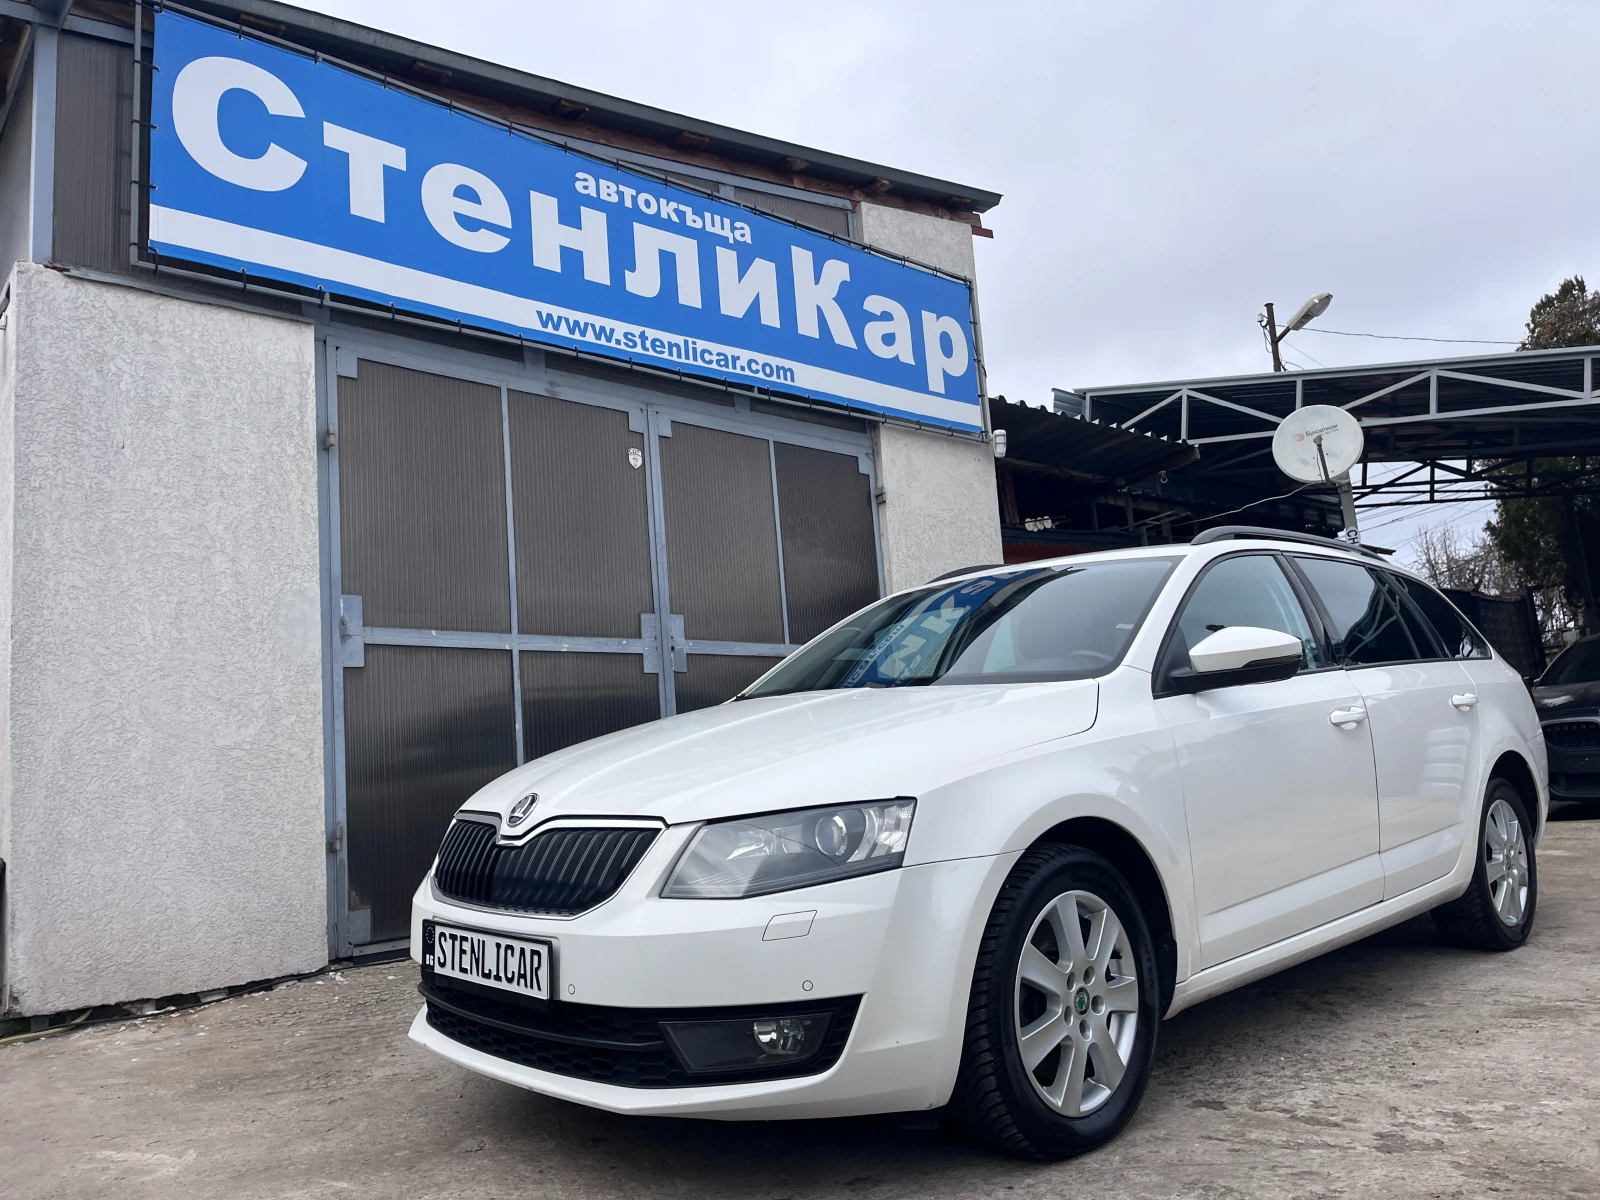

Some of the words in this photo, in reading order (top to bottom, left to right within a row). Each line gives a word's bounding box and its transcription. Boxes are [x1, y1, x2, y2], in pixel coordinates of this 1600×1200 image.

[172, 56, 969, 394] СтенлиКар
[574, 171, 752, 244] автокъща
[536, 309, 795, 383] www.stenlicar.com
[425, 953, 434, 966] BG
[437, 931, 542, 992] STENLICAR
